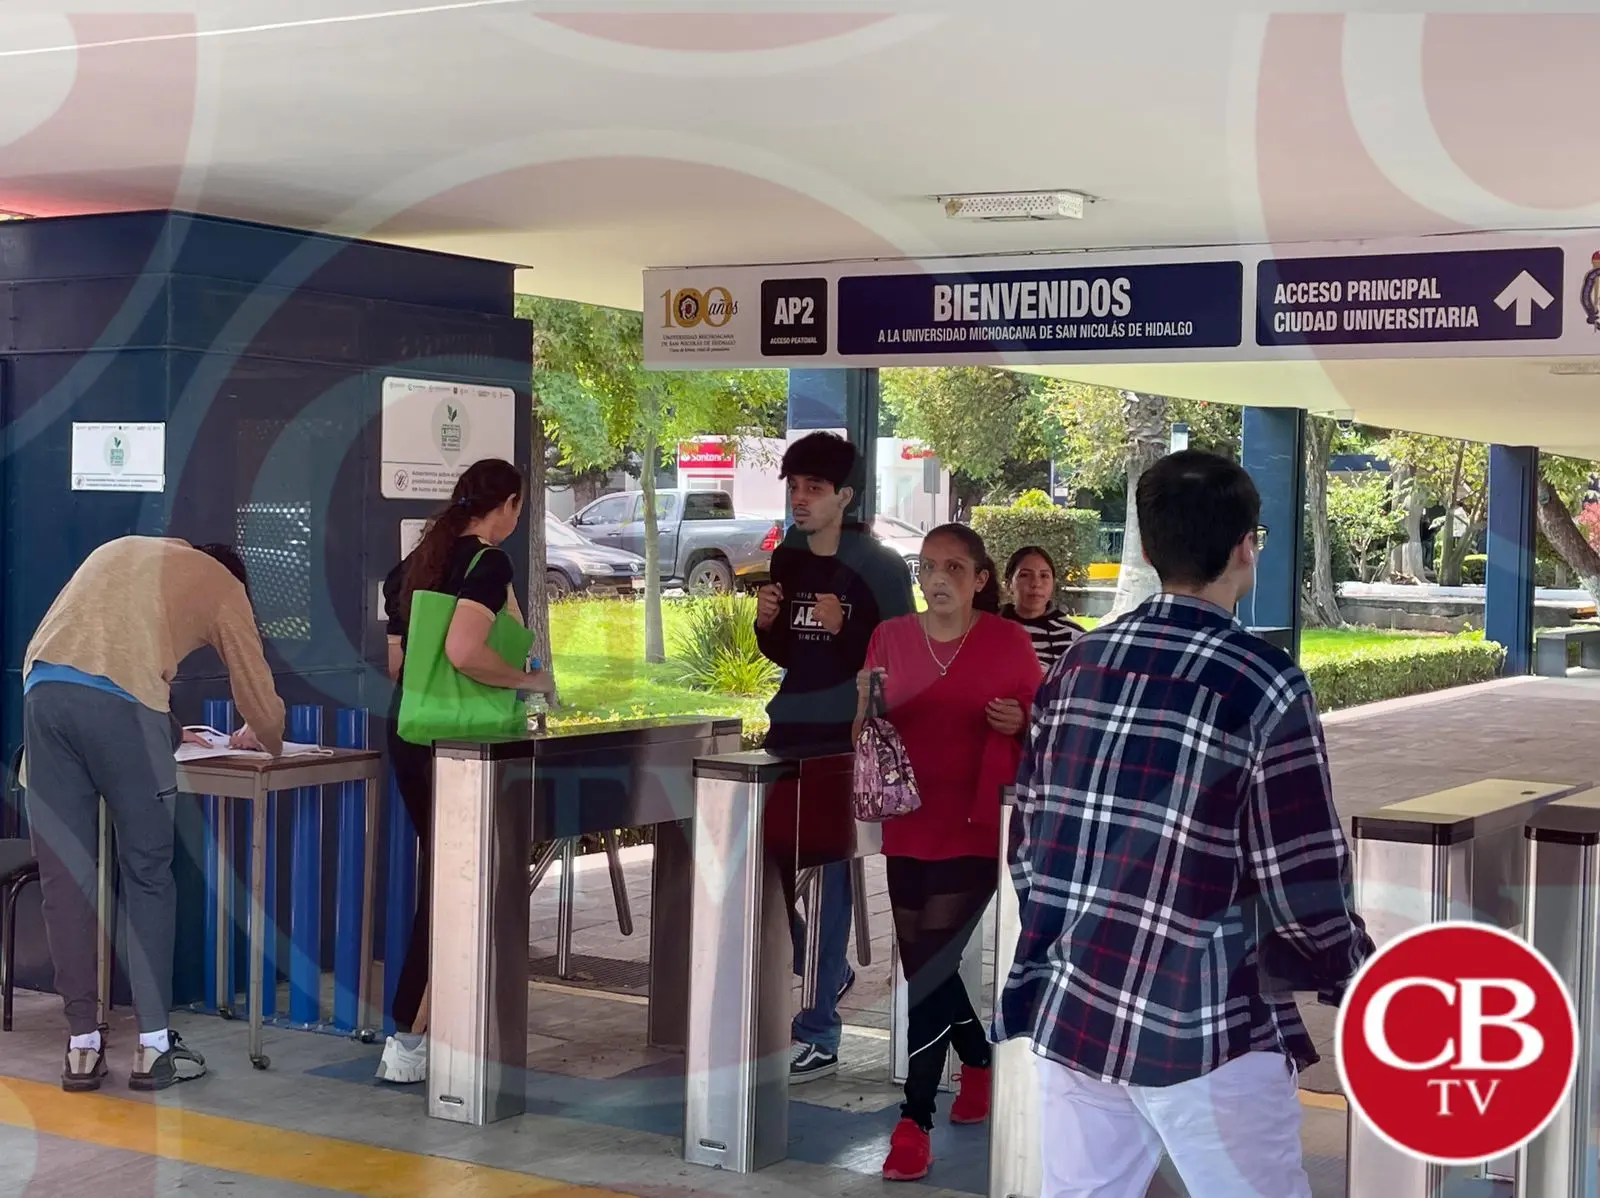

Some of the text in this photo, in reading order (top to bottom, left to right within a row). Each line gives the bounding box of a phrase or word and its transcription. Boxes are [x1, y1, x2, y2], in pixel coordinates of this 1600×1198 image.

[933, 277, 1132, 322] BIENVENIDOS
[1274, 277, 1441, 304] ACCESO PRINCIPAL
[660, 287, 739, 328] 100 años
[774, 297, 815, 325] AP2
[1274, 306, 1479, 333] CIUDAD UNIVERSITARIA
[770, 336, 818, 345] ACCESO PEATONAL
[878, 320, 1193, 343] A LA UNIVERSIDAD MICHOACANA DE SAN NICOLÁS DE HIDALGO
